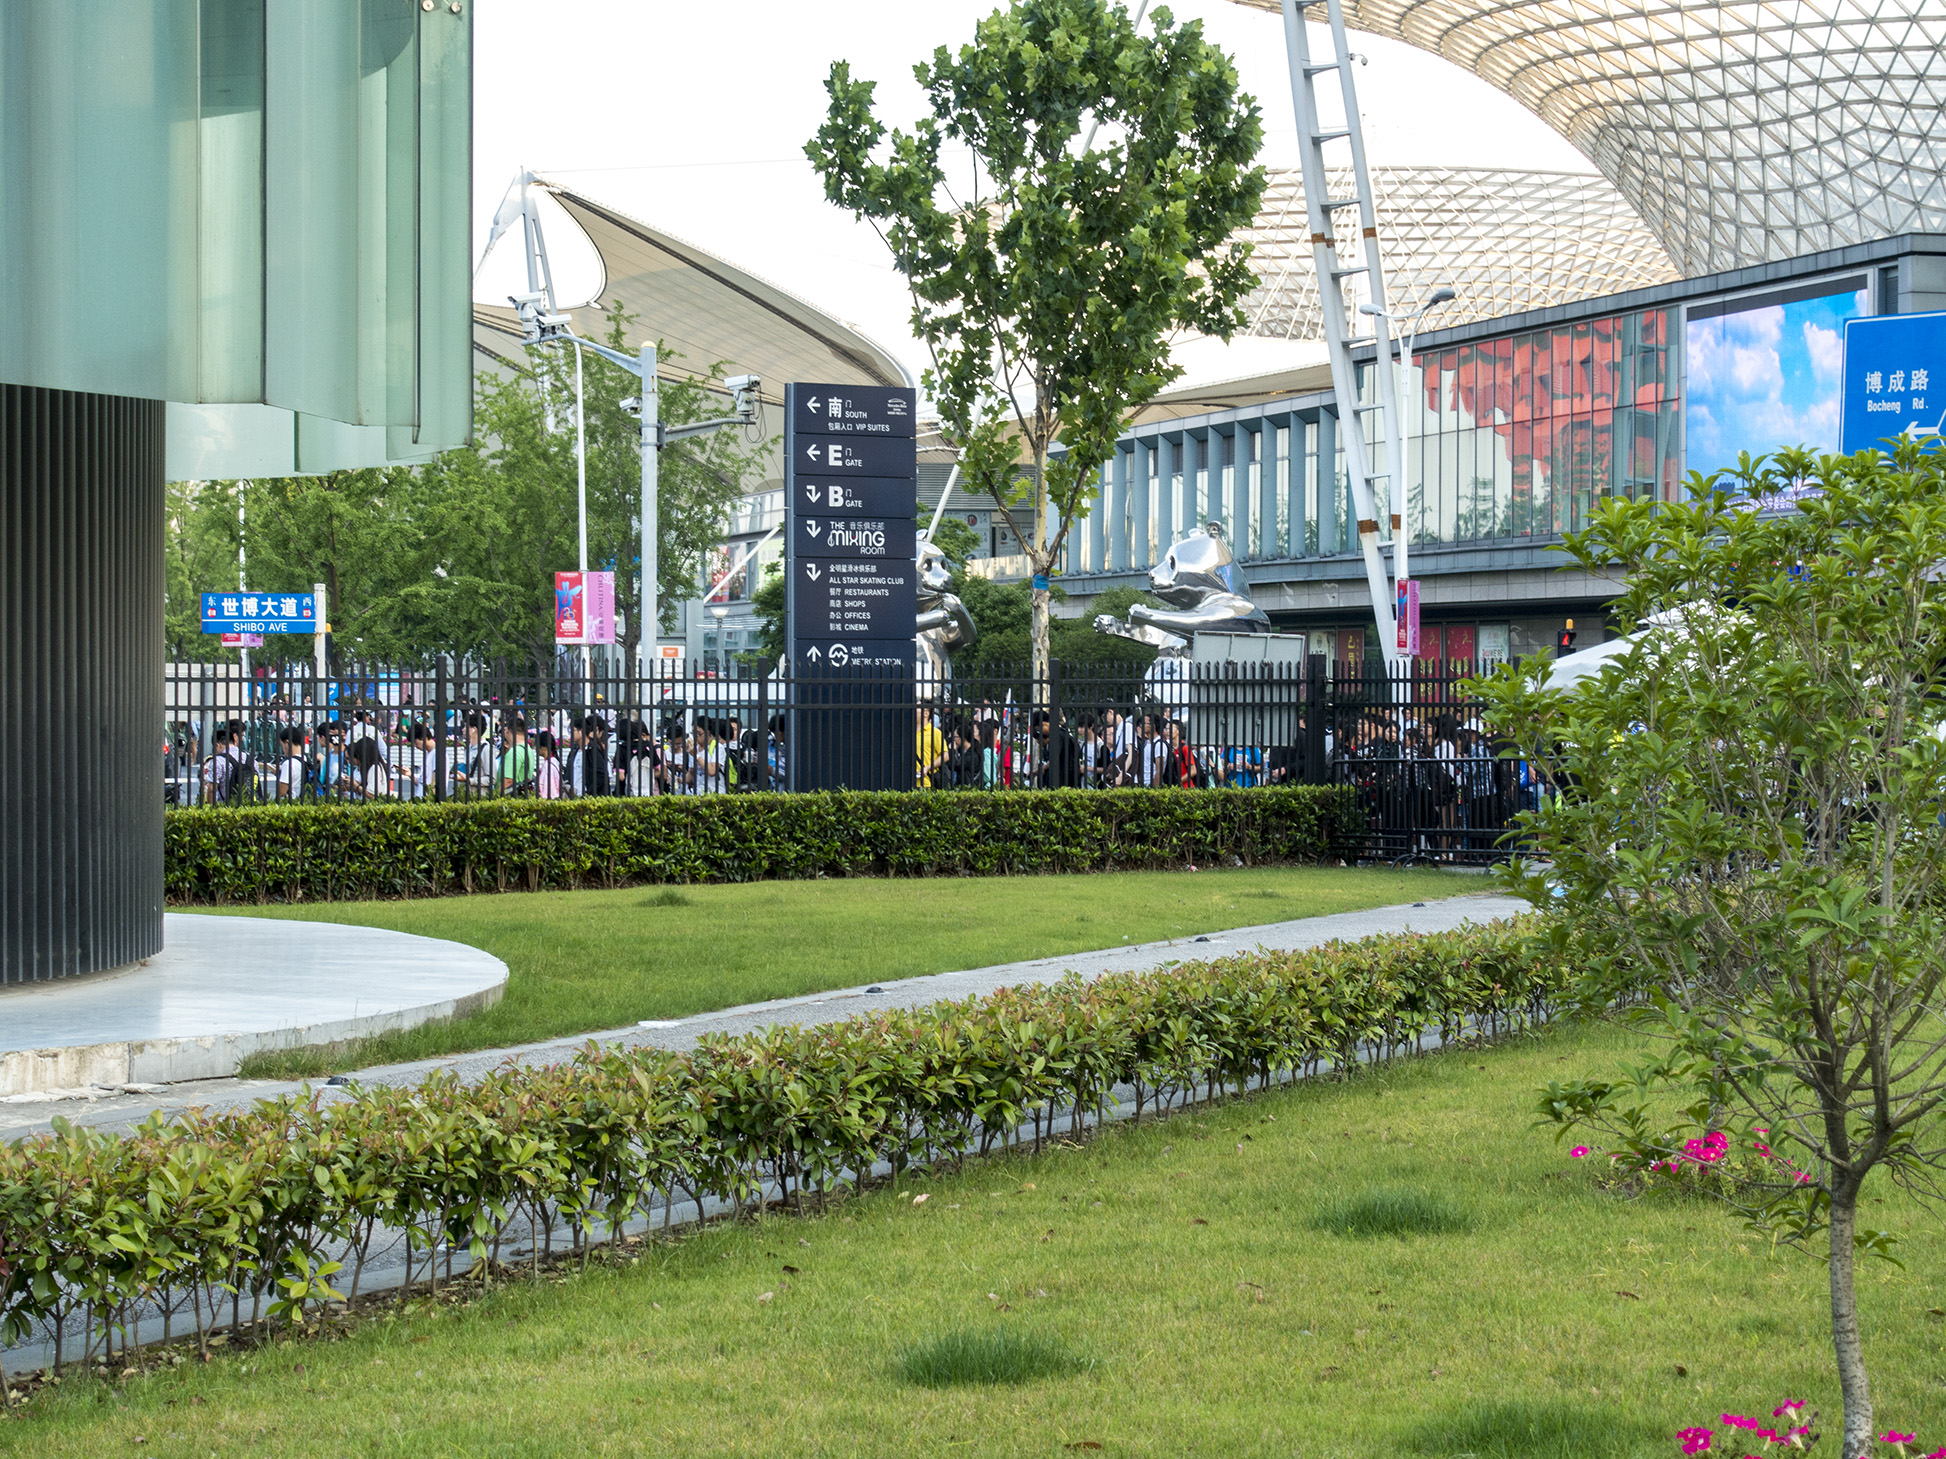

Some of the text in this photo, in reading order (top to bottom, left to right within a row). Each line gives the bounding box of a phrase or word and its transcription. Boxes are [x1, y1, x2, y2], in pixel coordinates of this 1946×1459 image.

[1865, 368, 1929, 394] 博成路
[828, 397, 842, 418] 南
[1867, 397, 1929, 414] Bocheng Rd.
[845, 411, 867, 419] SOUTH
[855, 423, 867, 431] VIP
[867, 424, 890, 432] SUITES
[828, 444, 843, 467] E
[845, 459, 863, 467] GATE
[828, 485, 844, 508] B
[845, 500, 863, 508] GATE
[830, 521, 846, 530] THE
[829, 576, 905, 585] ALL STAR SKATING CLUB
[844, 588, 890, 597] RESTAURANTS
[221, 597, 298, 617] 世博大道
[844, 600, 866, 608] SHOPS
[829, 612, 871, 620] 办公 OFFICES
[233, 622, 288, 632] SHIBO AVE
[844, 623, 869, 632] CINEMA
